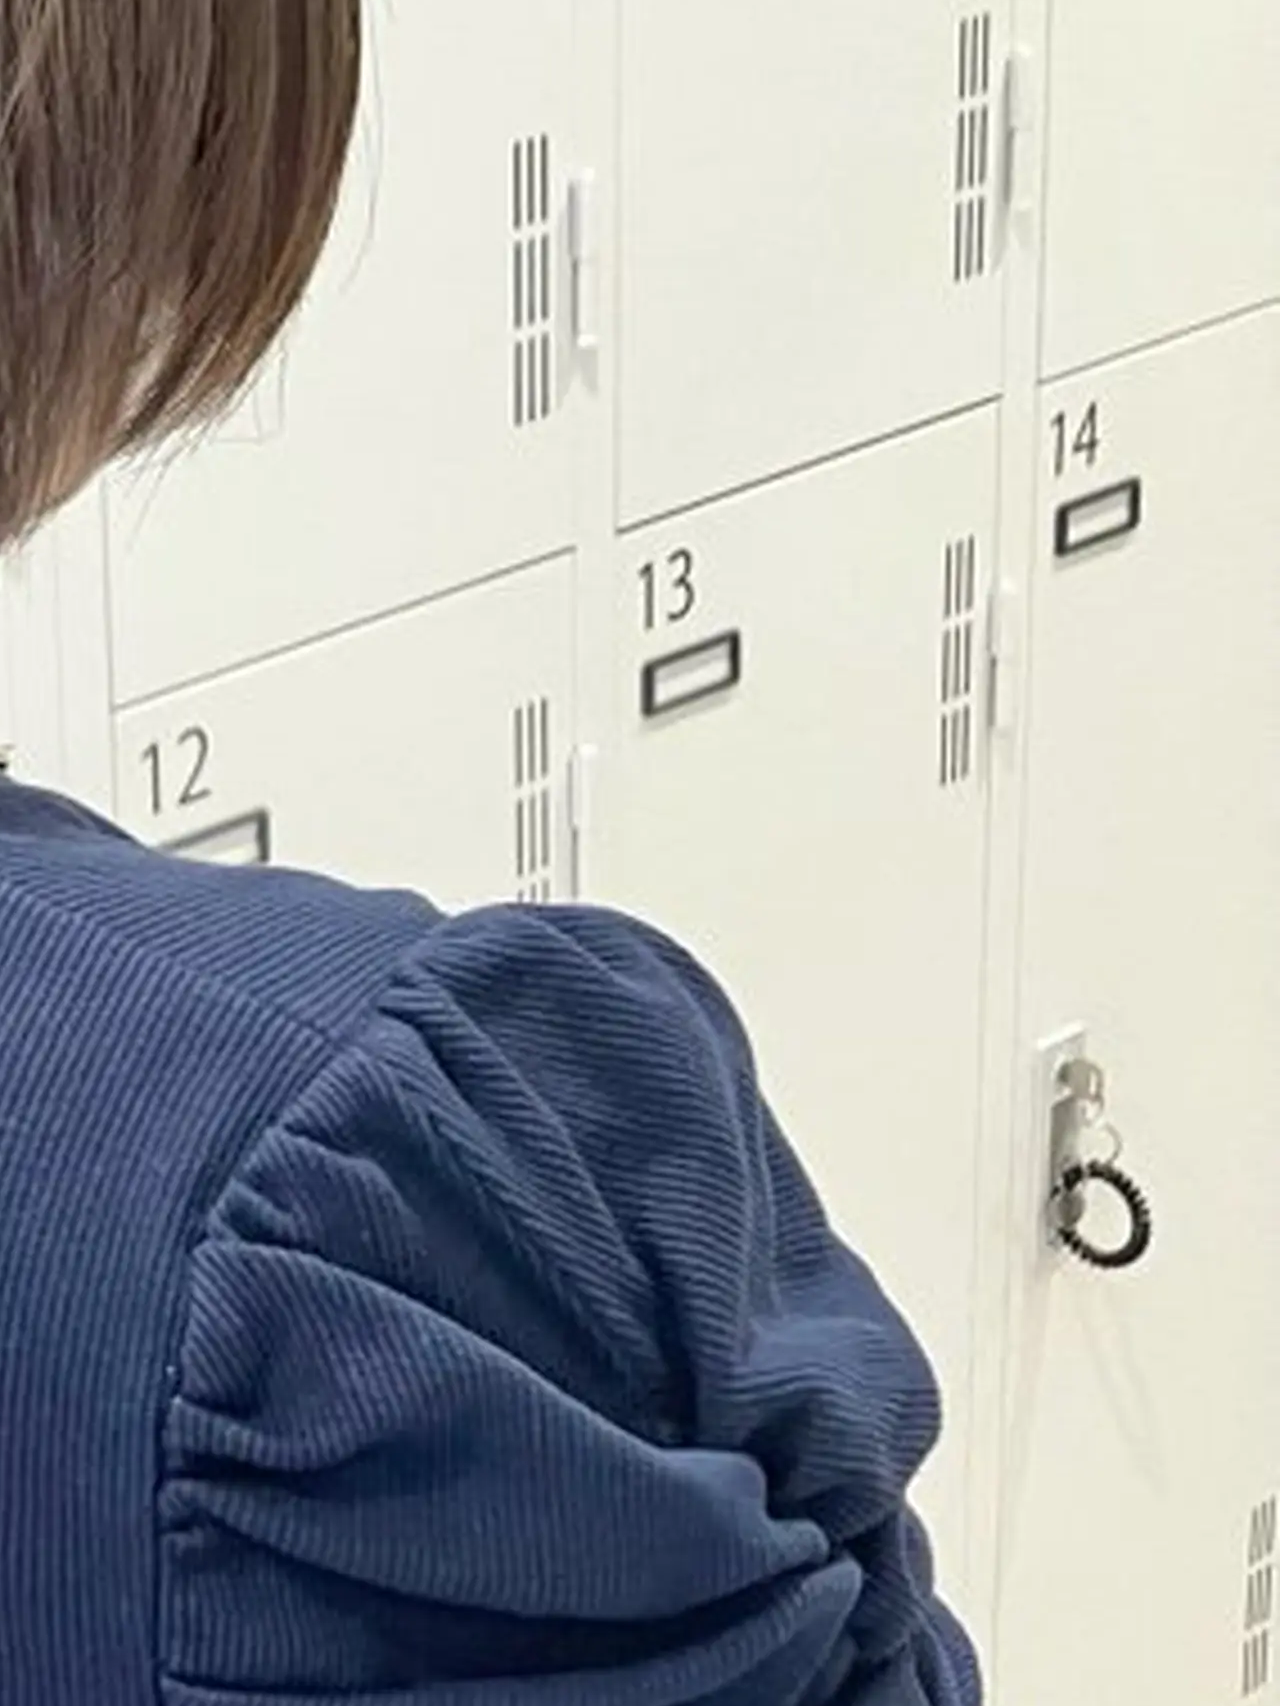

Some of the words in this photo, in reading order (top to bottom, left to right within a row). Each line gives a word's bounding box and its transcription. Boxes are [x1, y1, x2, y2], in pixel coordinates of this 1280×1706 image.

[1050, 400, 1100, 478] 14
[638, 547, 696, 631] 13
[141, 725, 213, 816] 12
